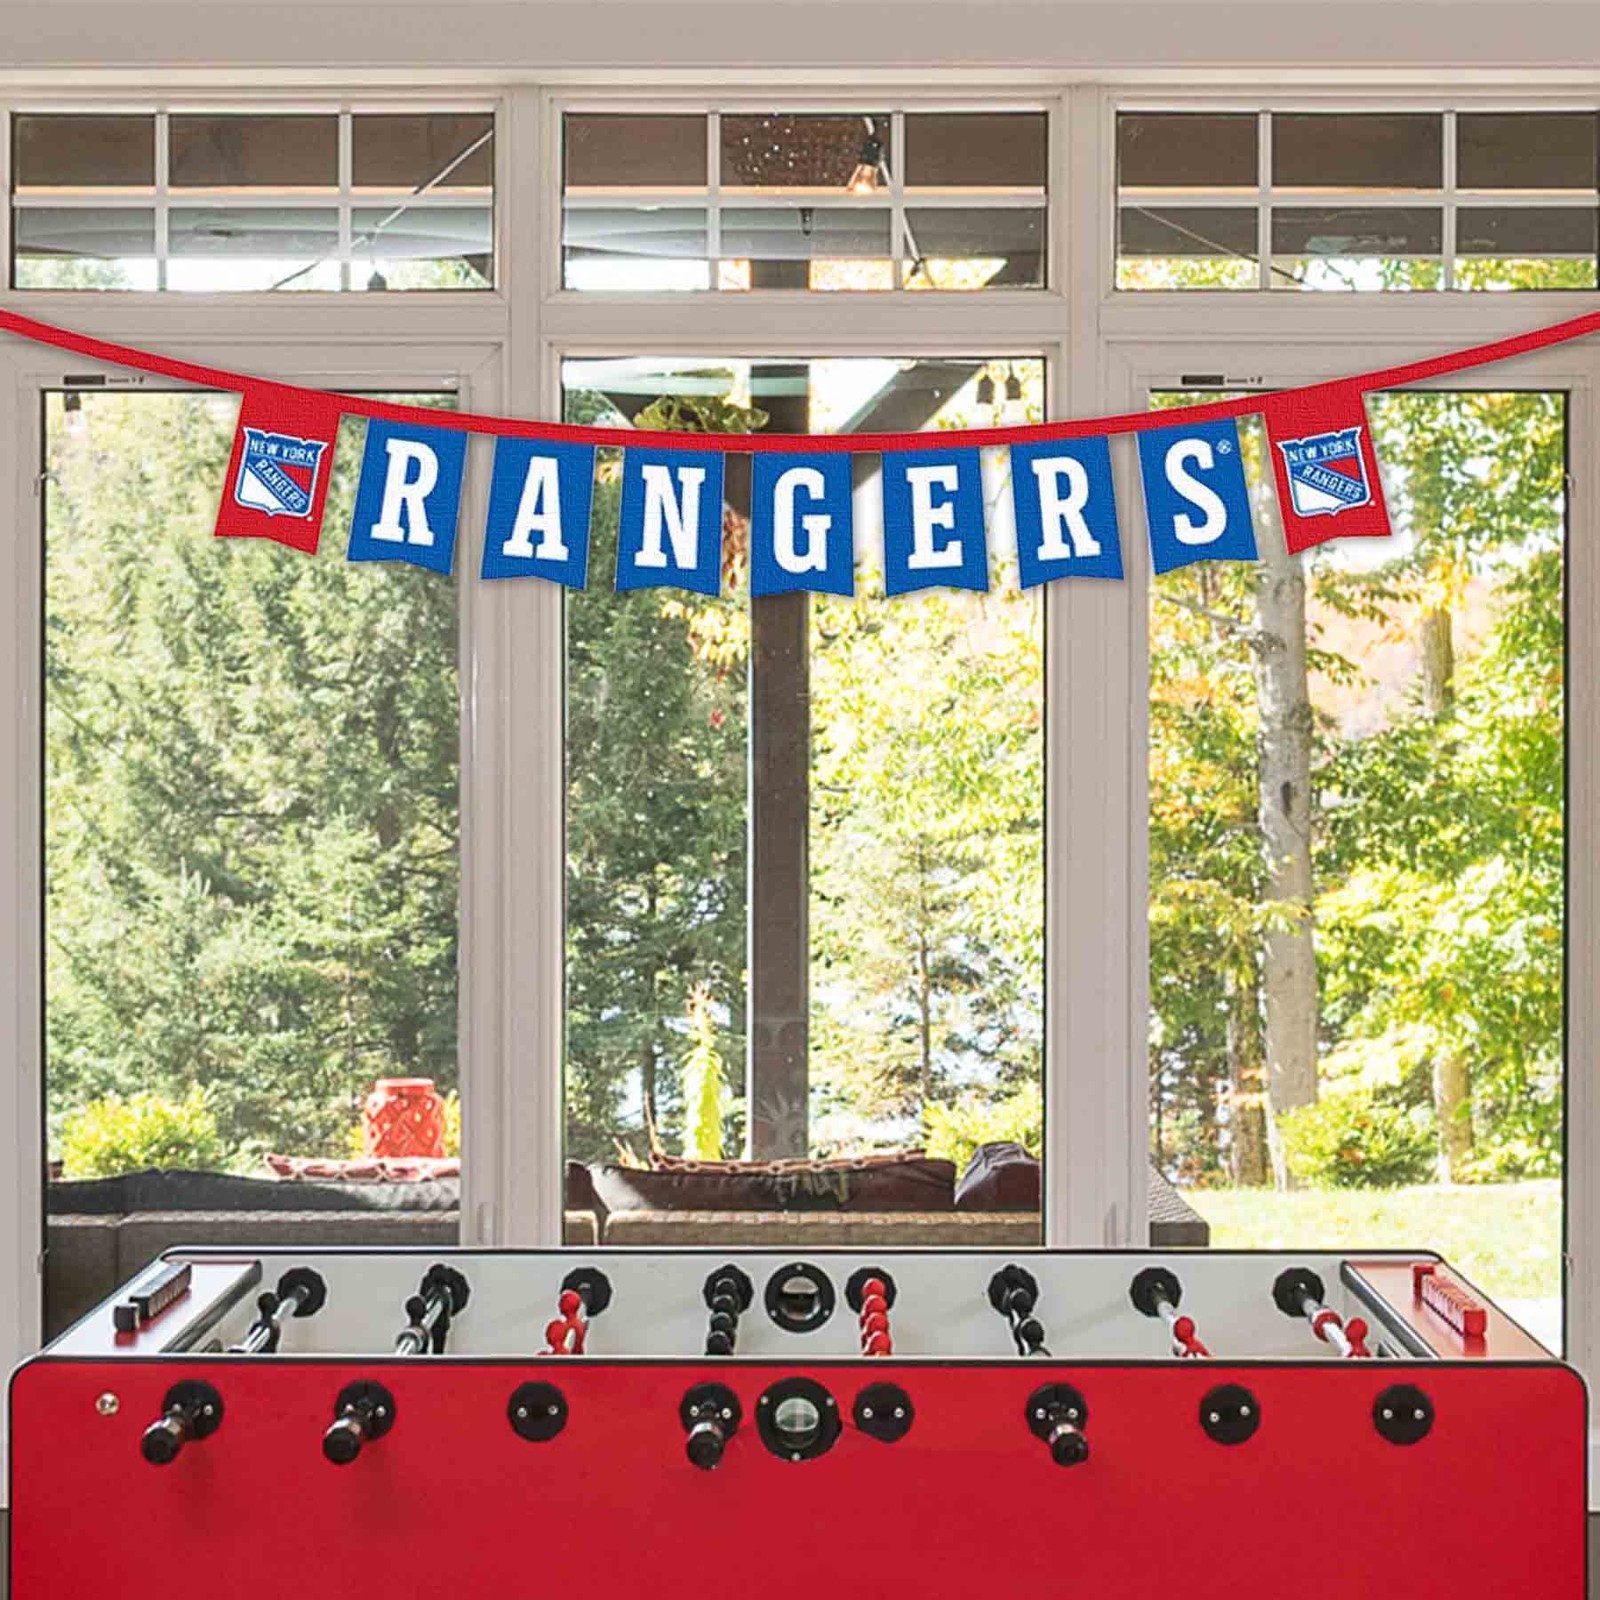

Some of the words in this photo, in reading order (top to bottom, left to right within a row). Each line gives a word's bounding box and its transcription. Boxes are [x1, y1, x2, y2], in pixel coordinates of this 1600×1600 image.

[250, 438, 279, 456] NEW
[283, 445, 315, 463] YORK
[1289, 446, 1317, 462] NEW
[1322, 439, 1355, 456] YORK
[255, 459, 306, 509] RANGERS
[1302, 465, 1363, 499] RANGERS
